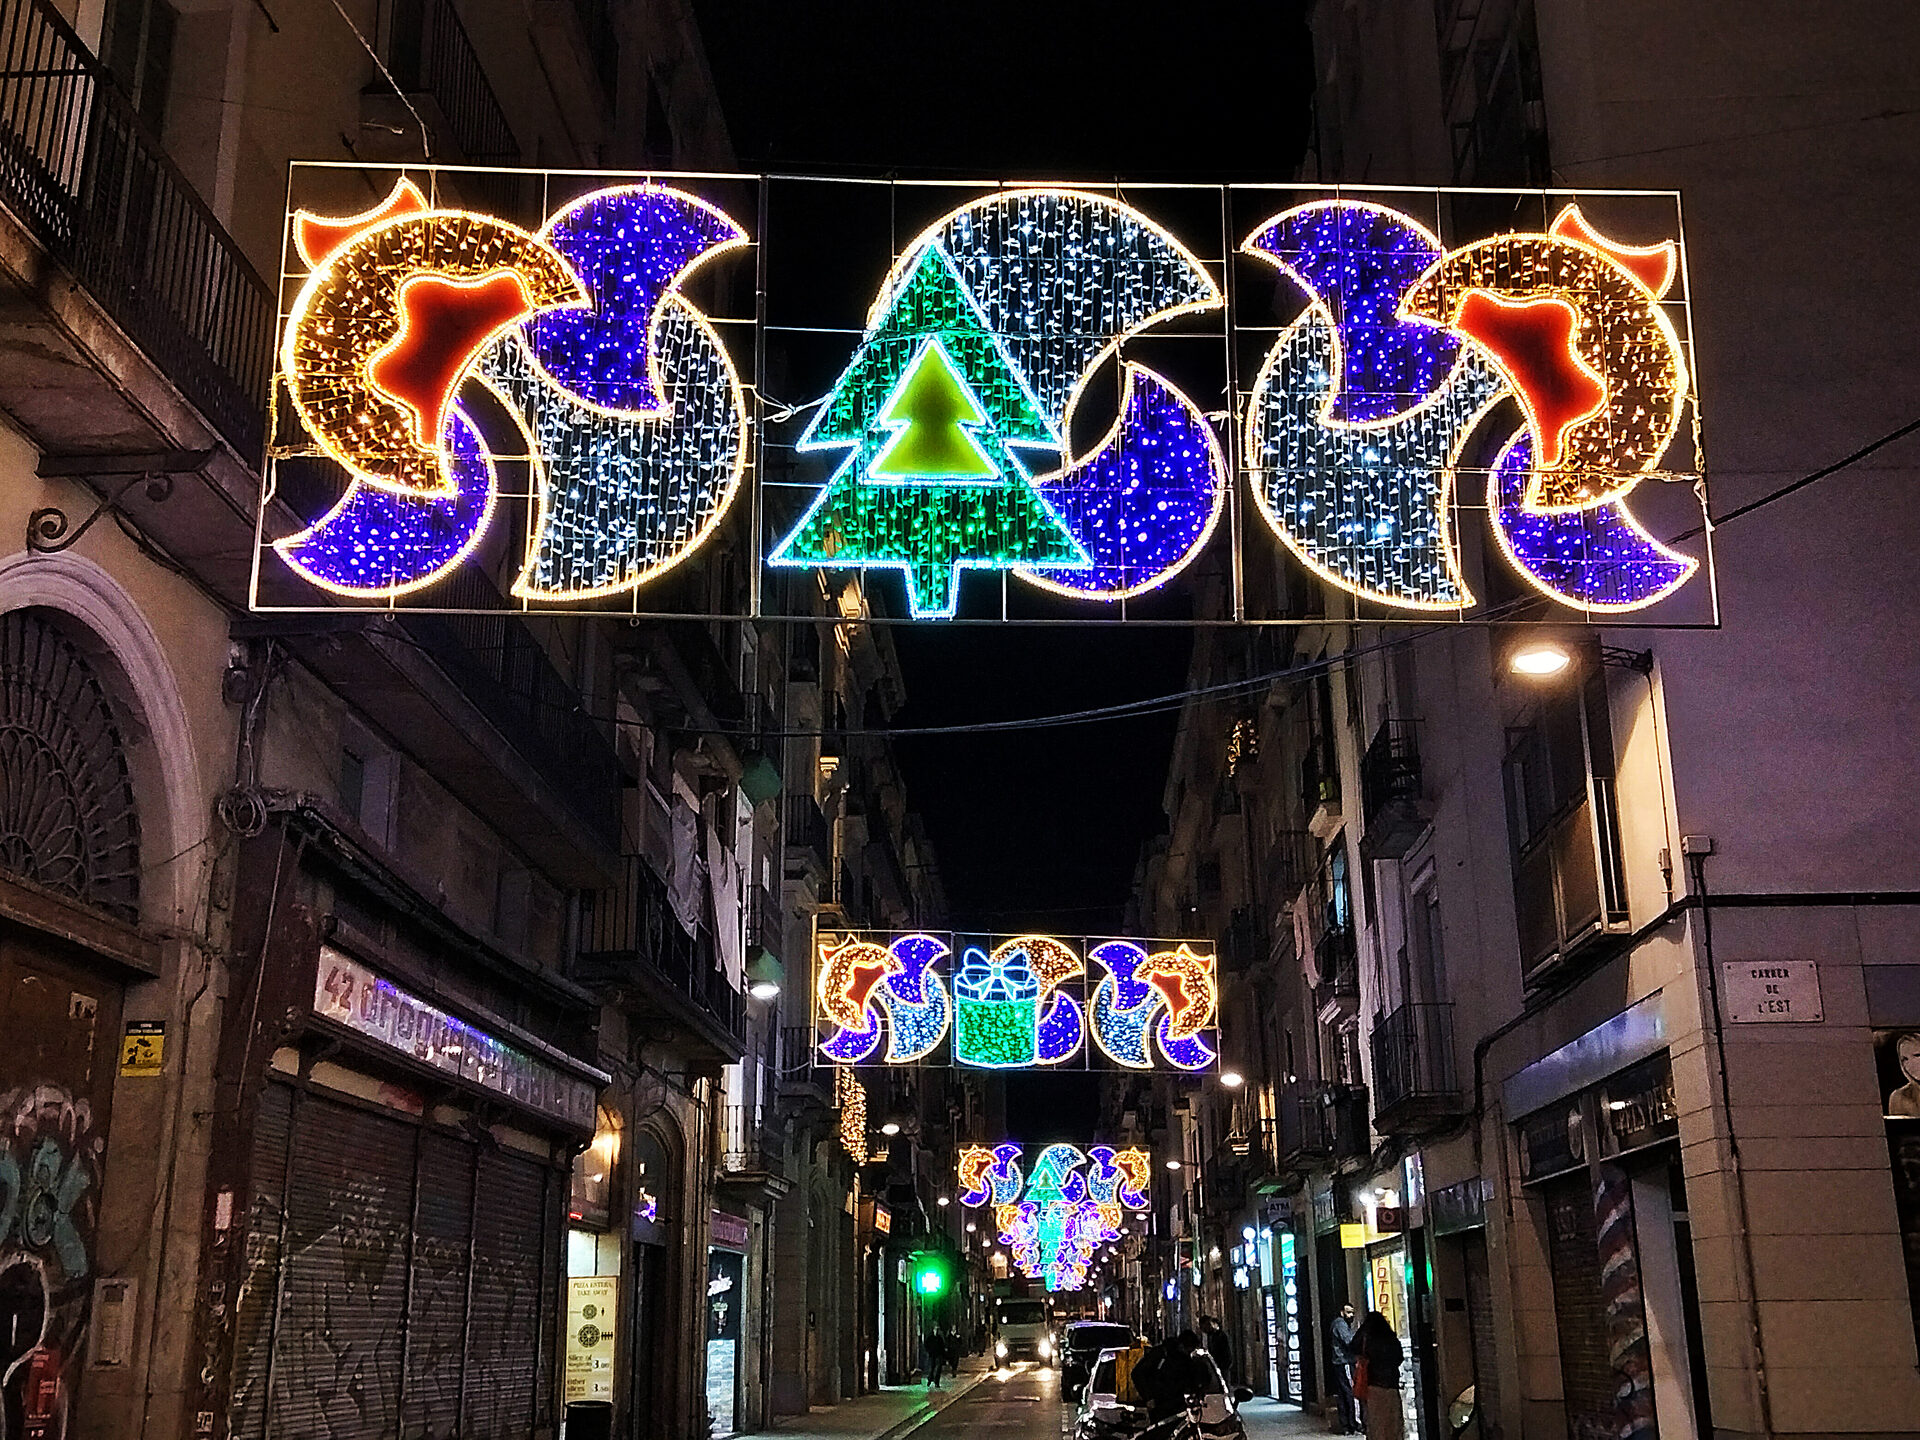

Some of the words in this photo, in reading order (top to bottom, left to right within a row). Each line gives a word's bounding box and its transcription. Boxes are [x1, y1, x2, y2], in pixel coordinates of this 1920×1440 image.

[1751, 968, 1790, 979] CARRER
[324, 966, 355, 1010] 42
[1765, 984, 1779, 995] DE
[1758, 1000, 1791, 1014] L'EST
[1269, 1202, 1290, 1211] ATM
